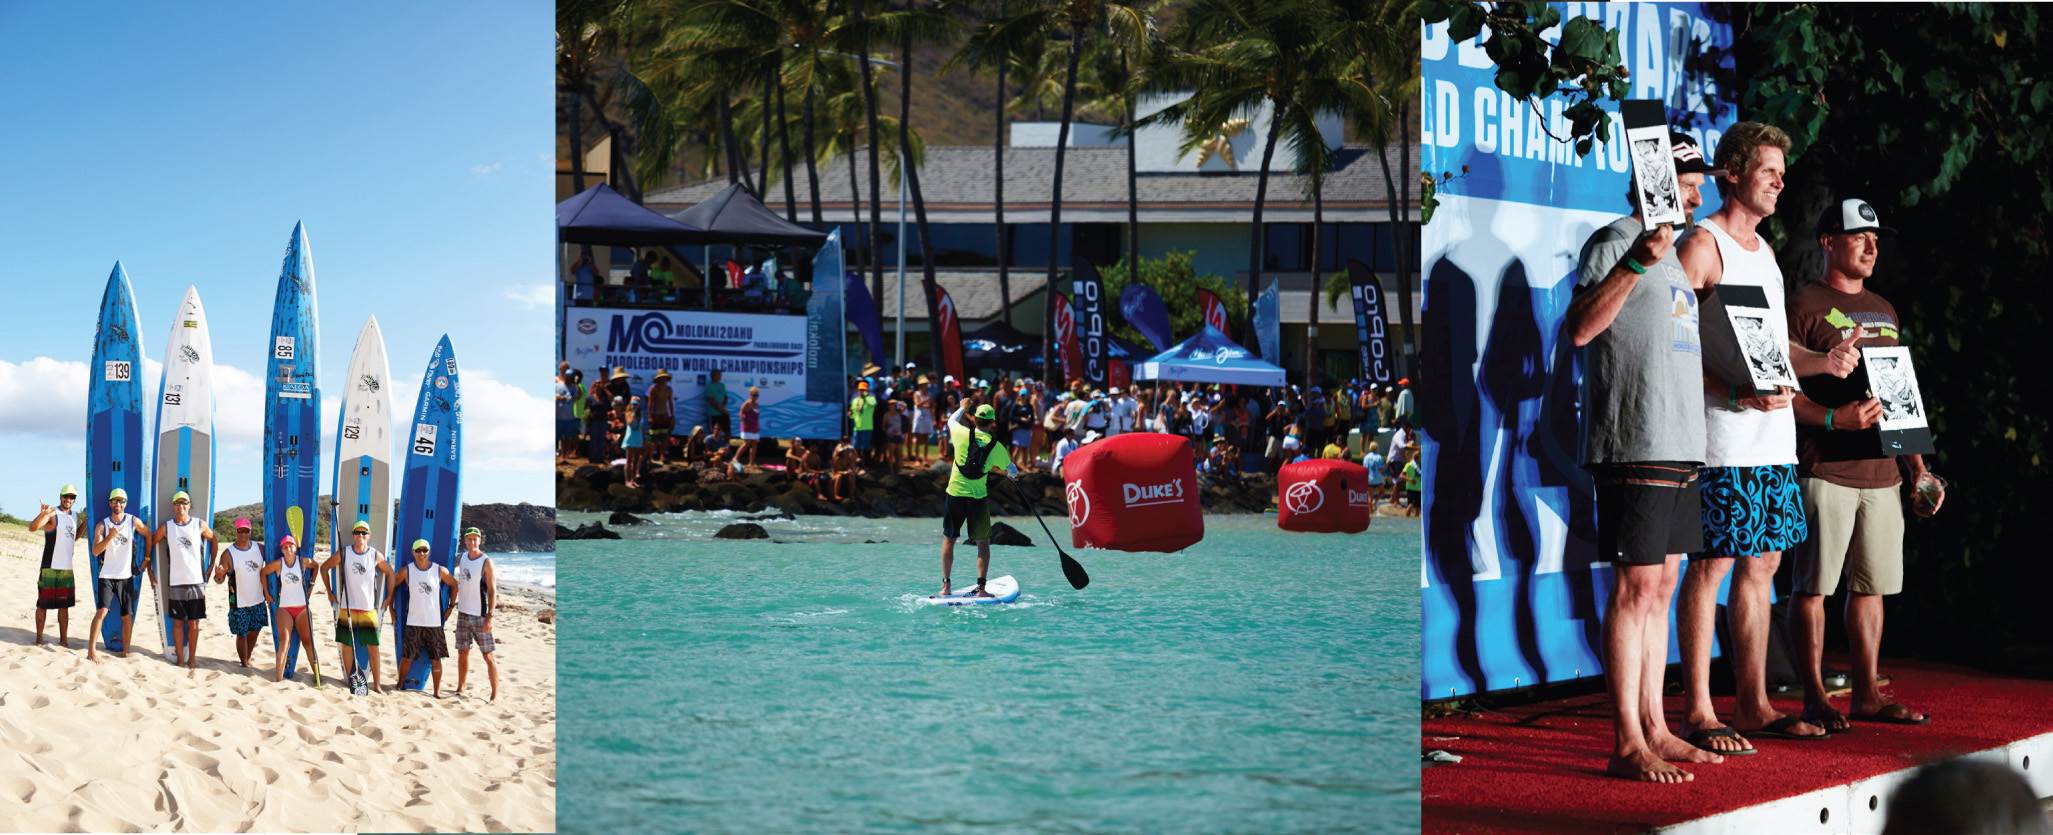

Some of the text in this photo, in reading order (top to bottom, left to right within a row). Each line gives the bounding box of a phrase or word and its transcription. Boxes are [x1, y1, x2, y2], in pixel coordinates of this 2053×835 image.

[277, 345, 292, 358] 85
[114, 363, 130, 379] 139
[719, 359, 804, 376] CHAMPIONSHIPS
[165, 393, 181, 406] 131
[421, 391, 431, 421] GARMIN
[344, 424, 360, 440] 129
[414, 437, 434, 454] 46
